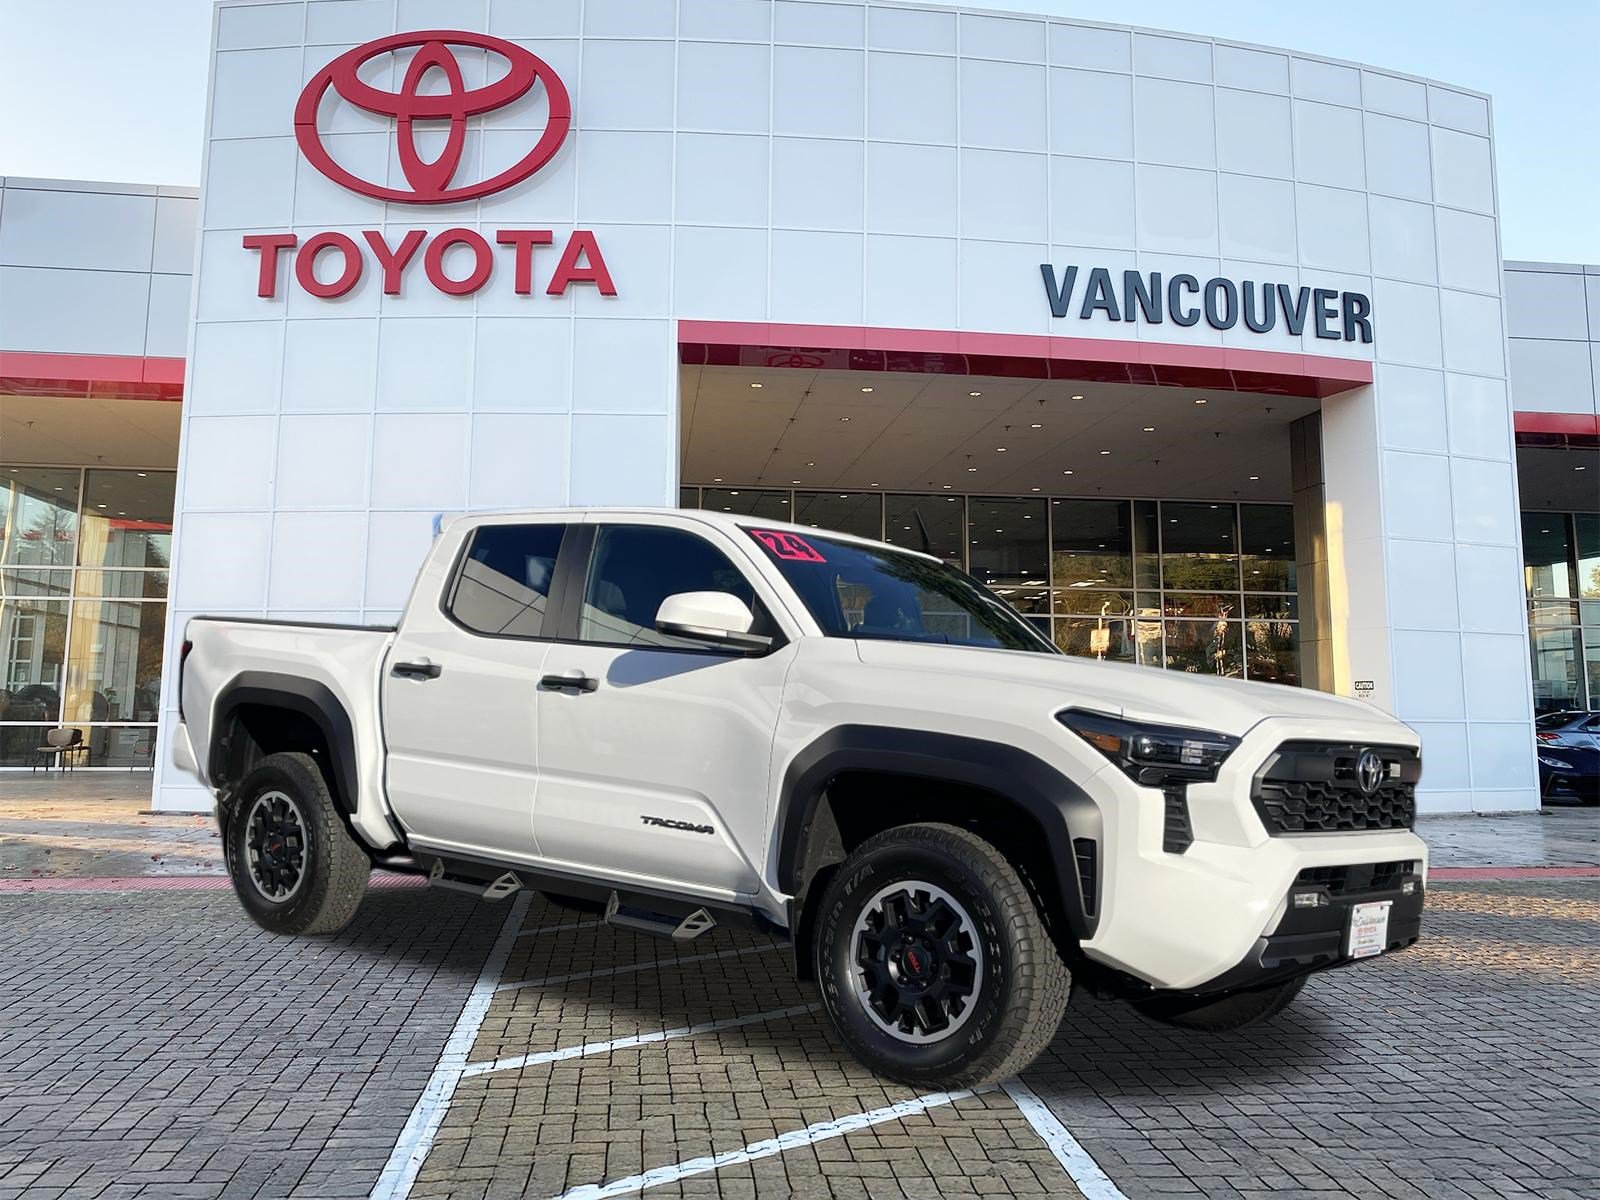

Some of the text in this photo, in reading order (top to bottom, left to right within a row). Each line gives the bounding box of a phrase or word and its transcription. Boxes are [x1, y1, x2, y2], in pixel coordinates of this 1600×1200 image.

[243, 228, 617, 298] TOYOTA
[1040, 264, 1373, 343] VANCOUVER
[640, 815, 715, 835] TACOMA
